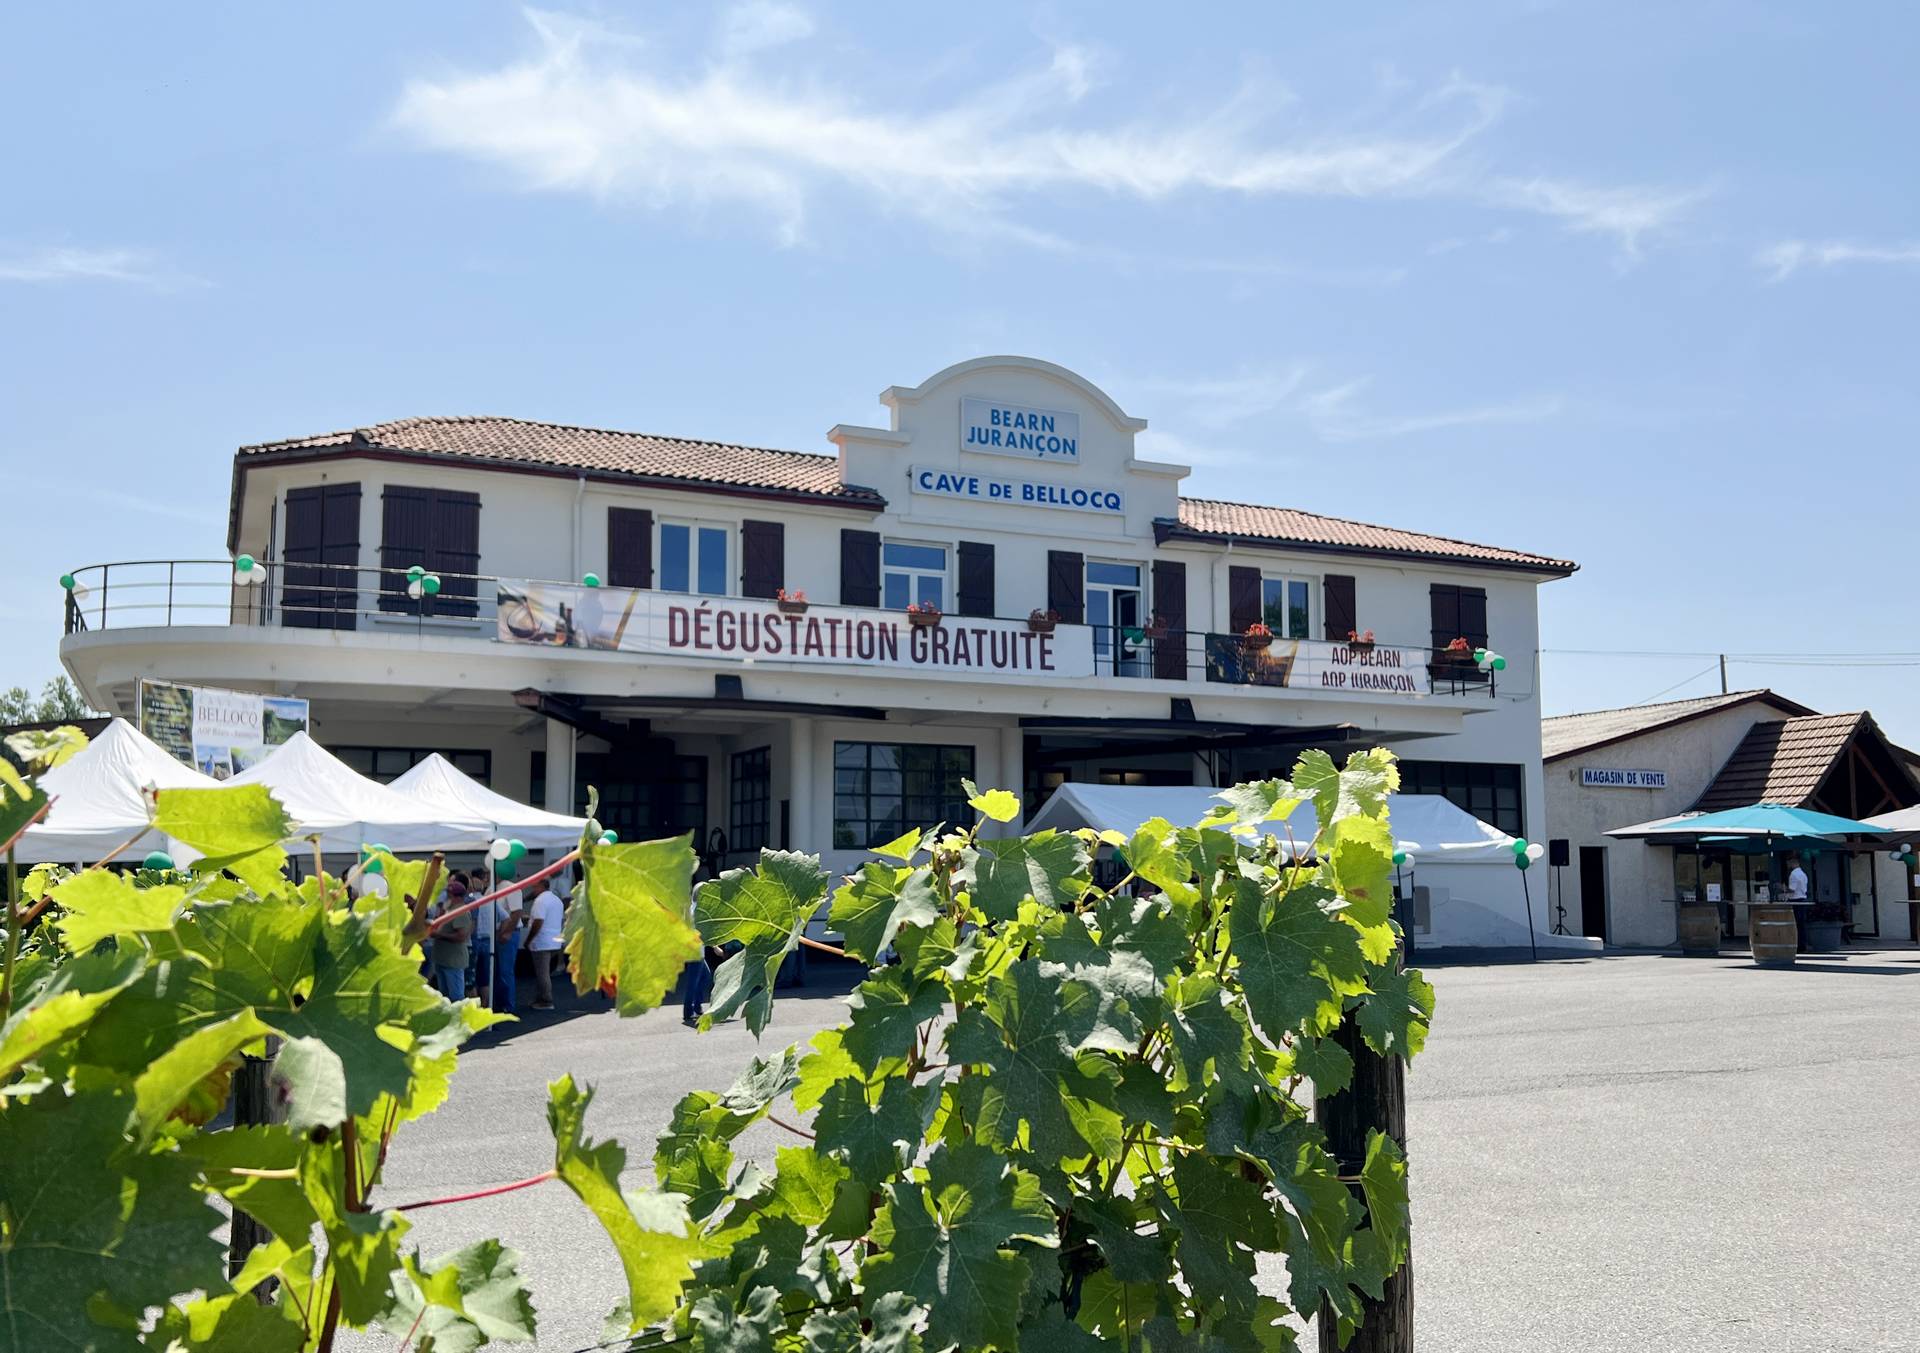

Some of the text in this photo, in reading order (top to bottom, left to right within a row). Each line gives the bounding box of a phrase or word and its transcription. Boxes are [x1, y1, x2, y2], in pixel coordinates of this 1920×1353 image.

[991, 408, 1055, 433] BEARN
[967, 426, 1076, 457] JURANÇON
[919, 471, 1121, 511] CAVE DE BELLOCQ
[668, 600, 1056, 671] DÉGUSTATION GRATUITE
[1332, 647, 1401, 668] AOP BEARN
[198, 706, 259, 728] BELLOCQ
[1584, 770, 1665, 786] MAGASIN DE VENTE
